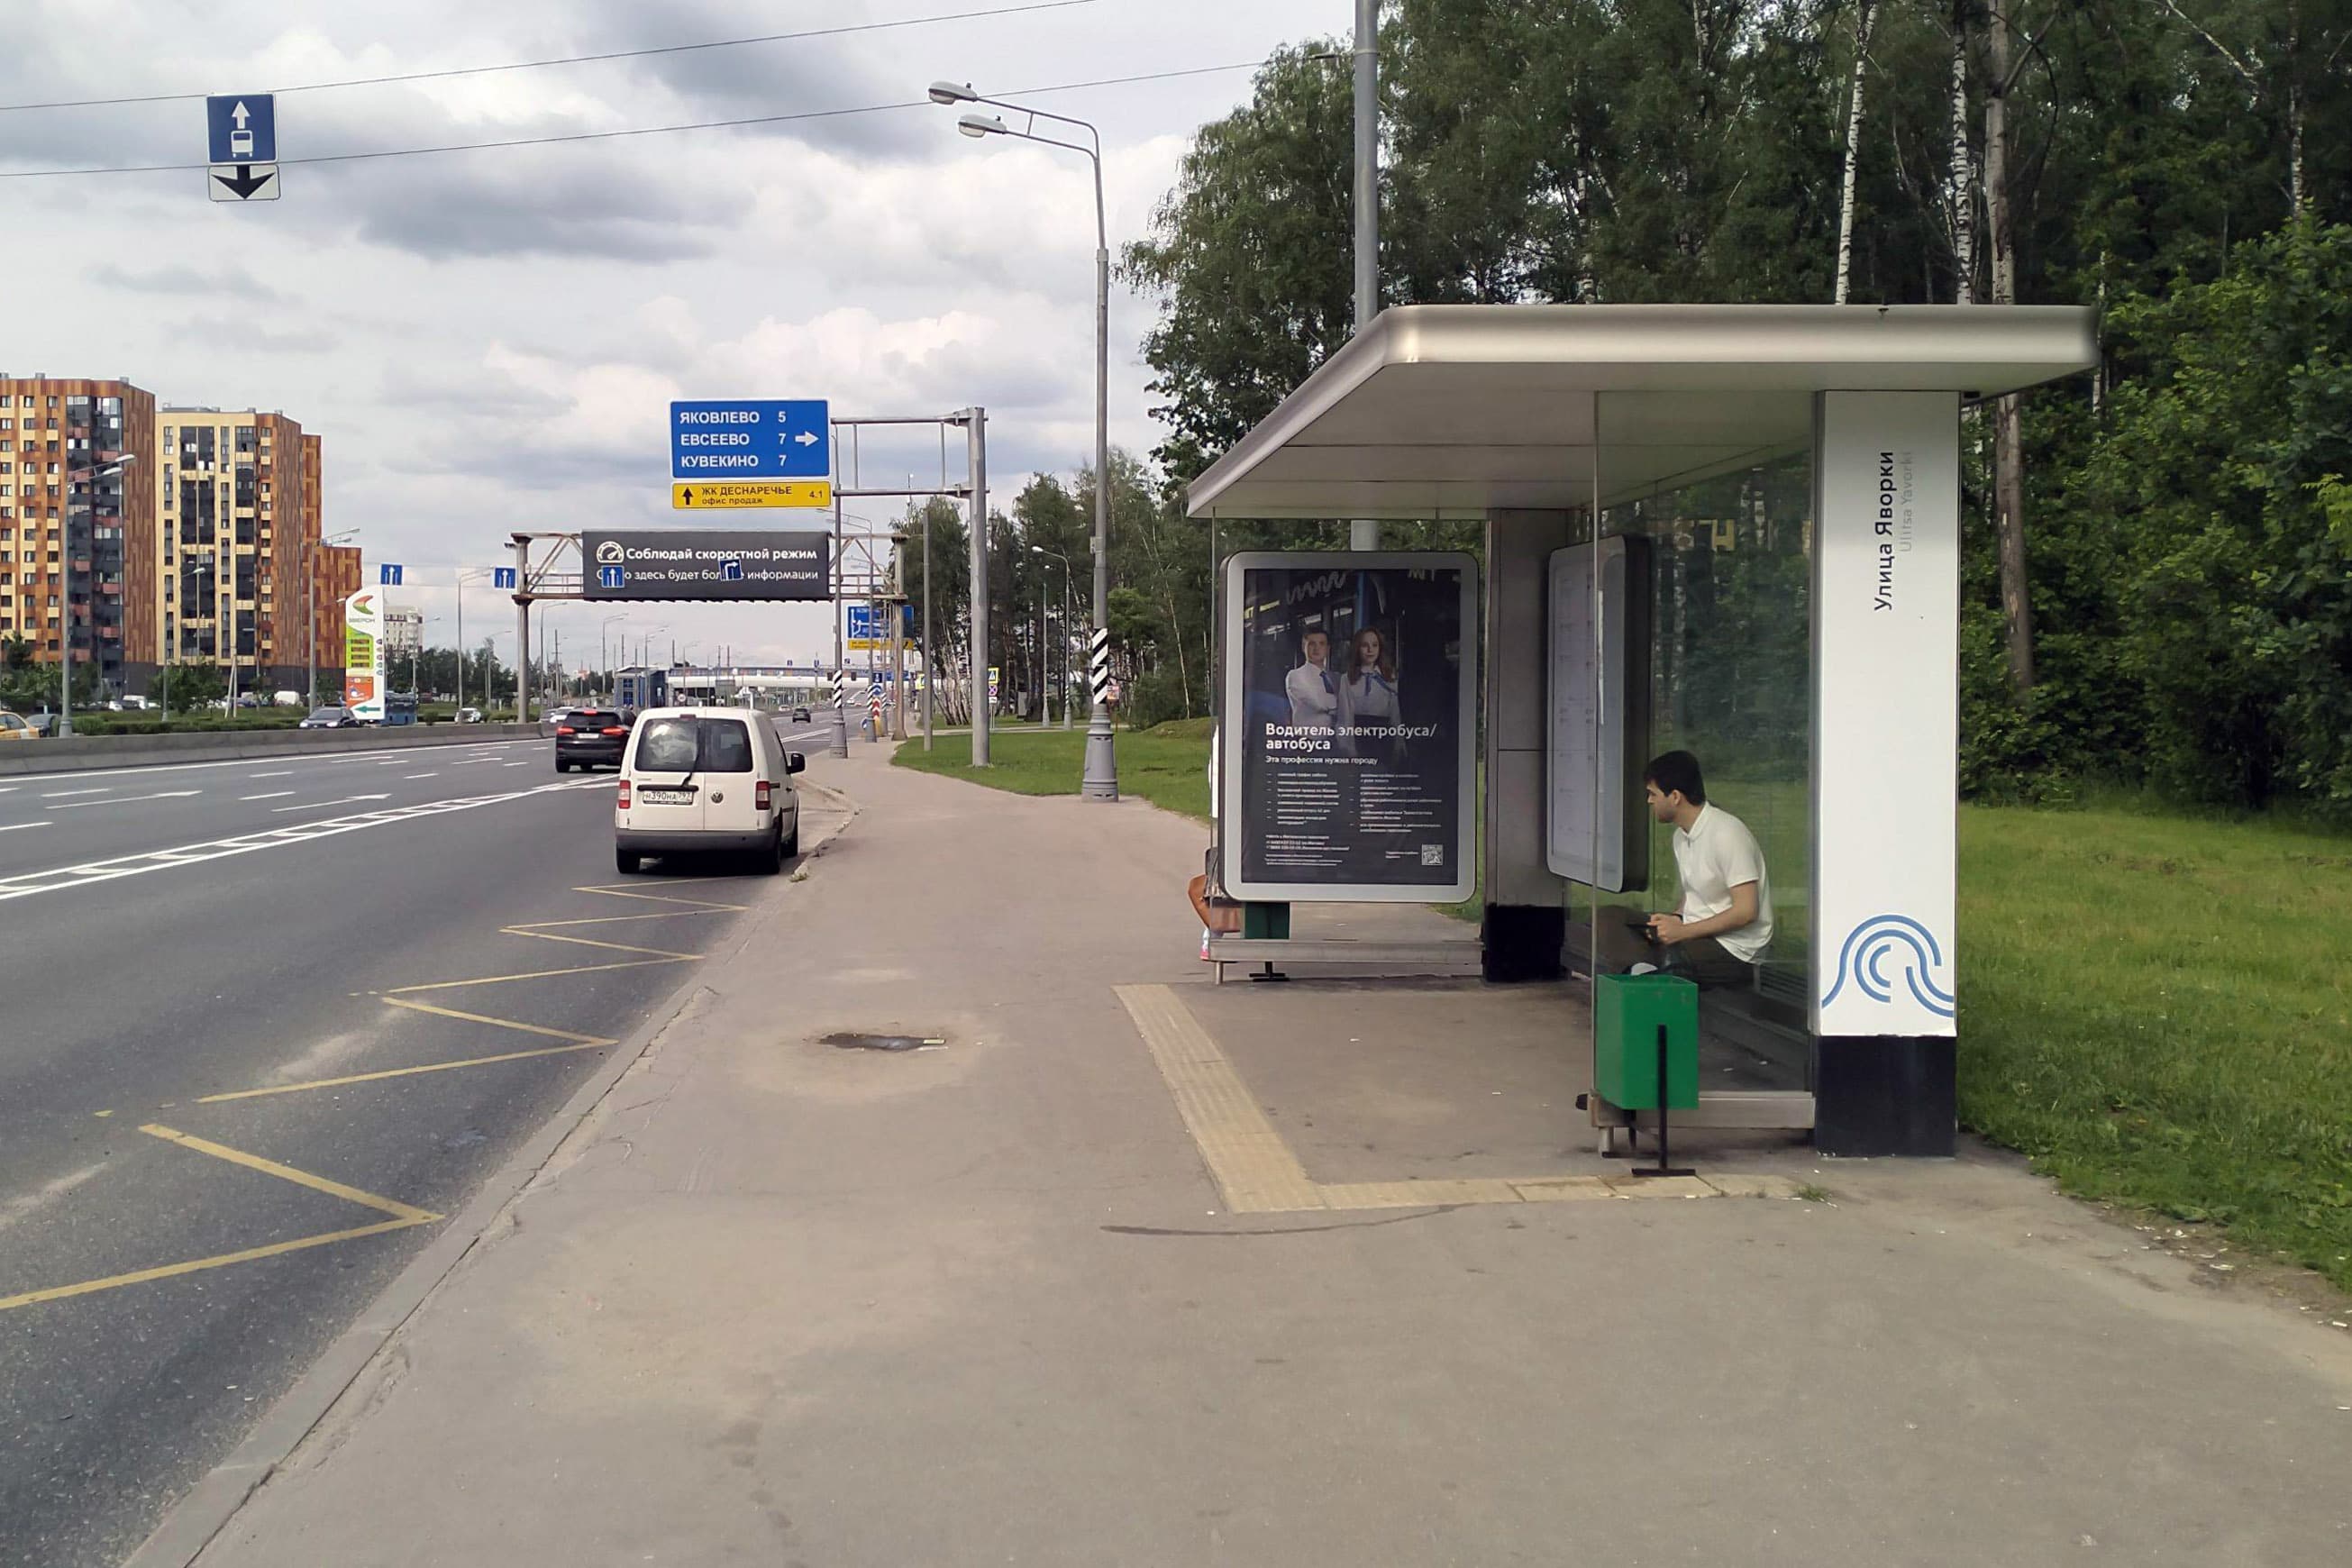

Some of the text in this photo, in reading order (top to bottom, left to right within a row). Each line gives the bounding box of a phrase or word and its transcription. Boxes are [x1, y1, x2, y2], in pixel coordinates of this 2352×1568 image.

[679, 411, 787, 424] ЯКОВЛЕВО 5
[680, 433, 787, 446] ЕВСЕЕВО 7
[680, 455, 787, 468] КУВЕКИНО 7
[701, 487, 718, 496] ЖК
[720, 486, 792, 497] ДЕСНАРЕЧЬЕ
[702, 497, 763, 506] офис продаж
[1901, 451, 1913, 552] Ulitsa Yavorki
[1874, 451, 1897, 611] Улица Яворки
[626, 548, 817, 563] Соблюдай скоростной режим
[634, 571, 666, 581] здесь
[668, 570, 700, 582] будет
[747, 570, 819, 582] информации
[1265, 723, 1437, 739] Водитель электробуса/
[1265, 737, 1331, 752] автобуса
[1265, 755, 1378, 766] Эта профессия нужна городу
